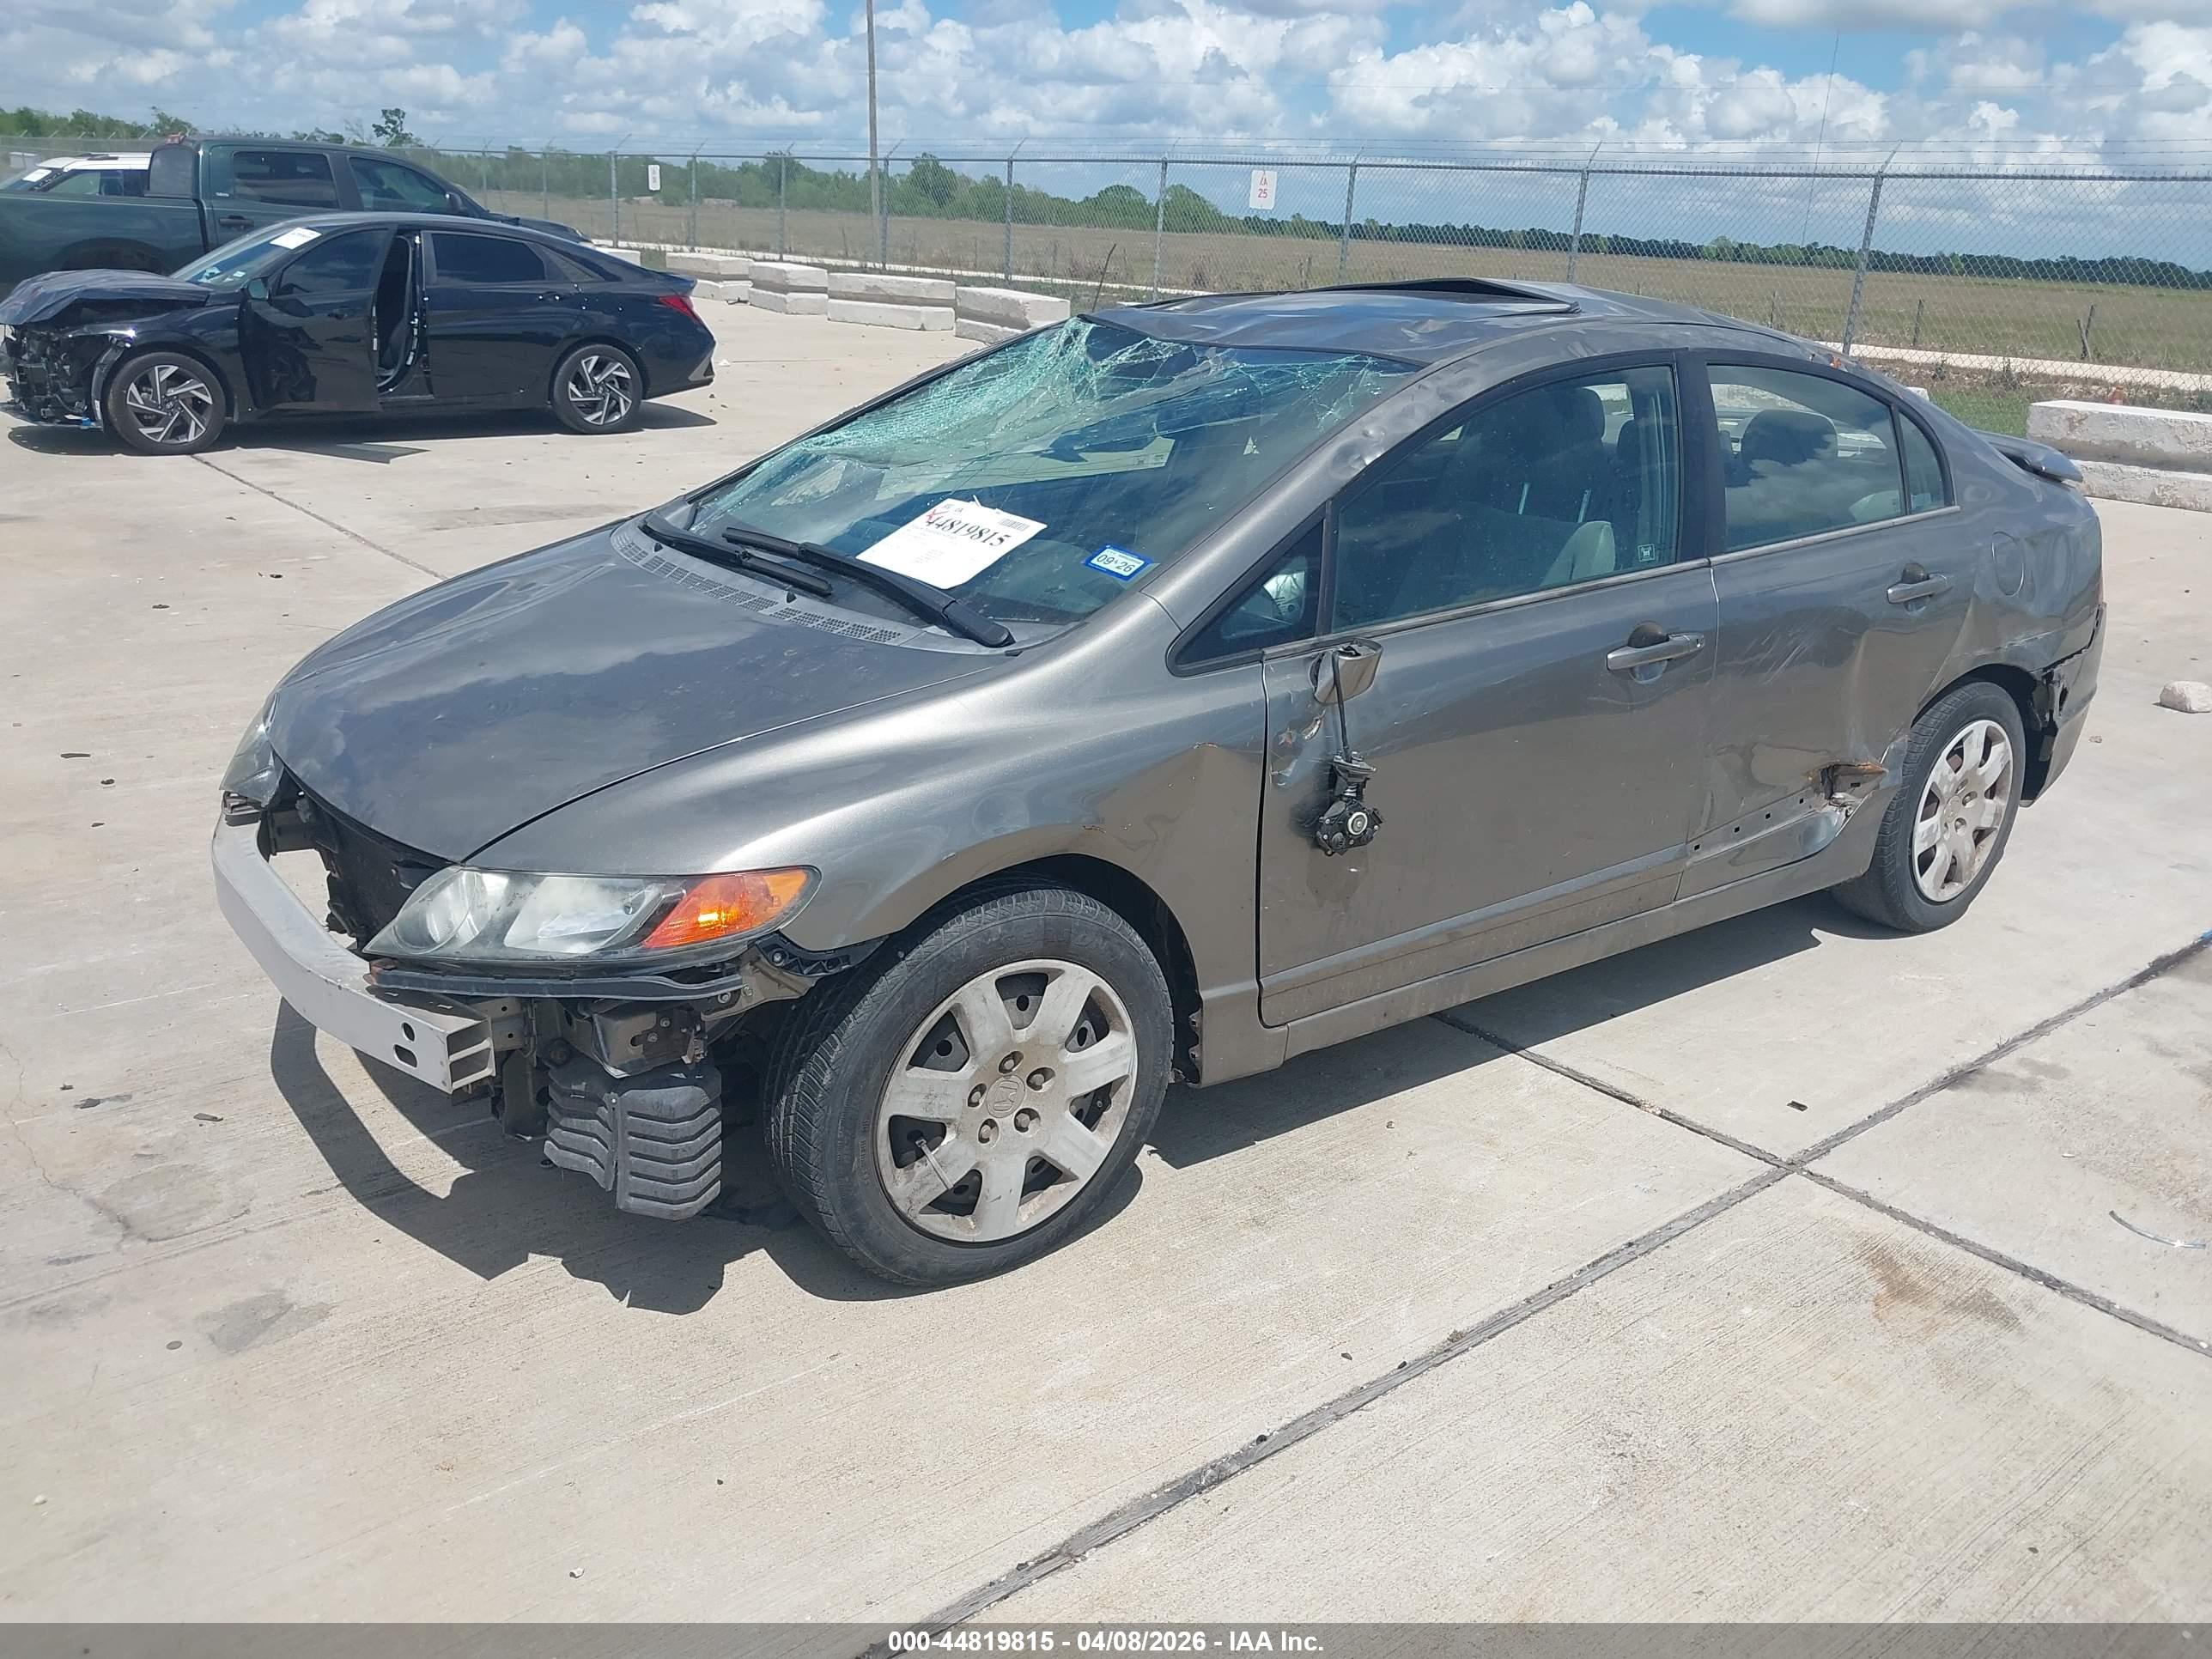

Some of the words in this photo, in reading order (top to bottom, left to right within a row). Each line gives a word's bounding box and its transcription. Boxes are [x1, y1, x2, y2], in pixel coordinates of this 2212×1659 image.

[1257, 188, 1268, 198] 25
[926, 515, 1012, 547] 44819815
[1097, 554, 1115, 565] 09
[1115, 562, 1135, 573] 26
